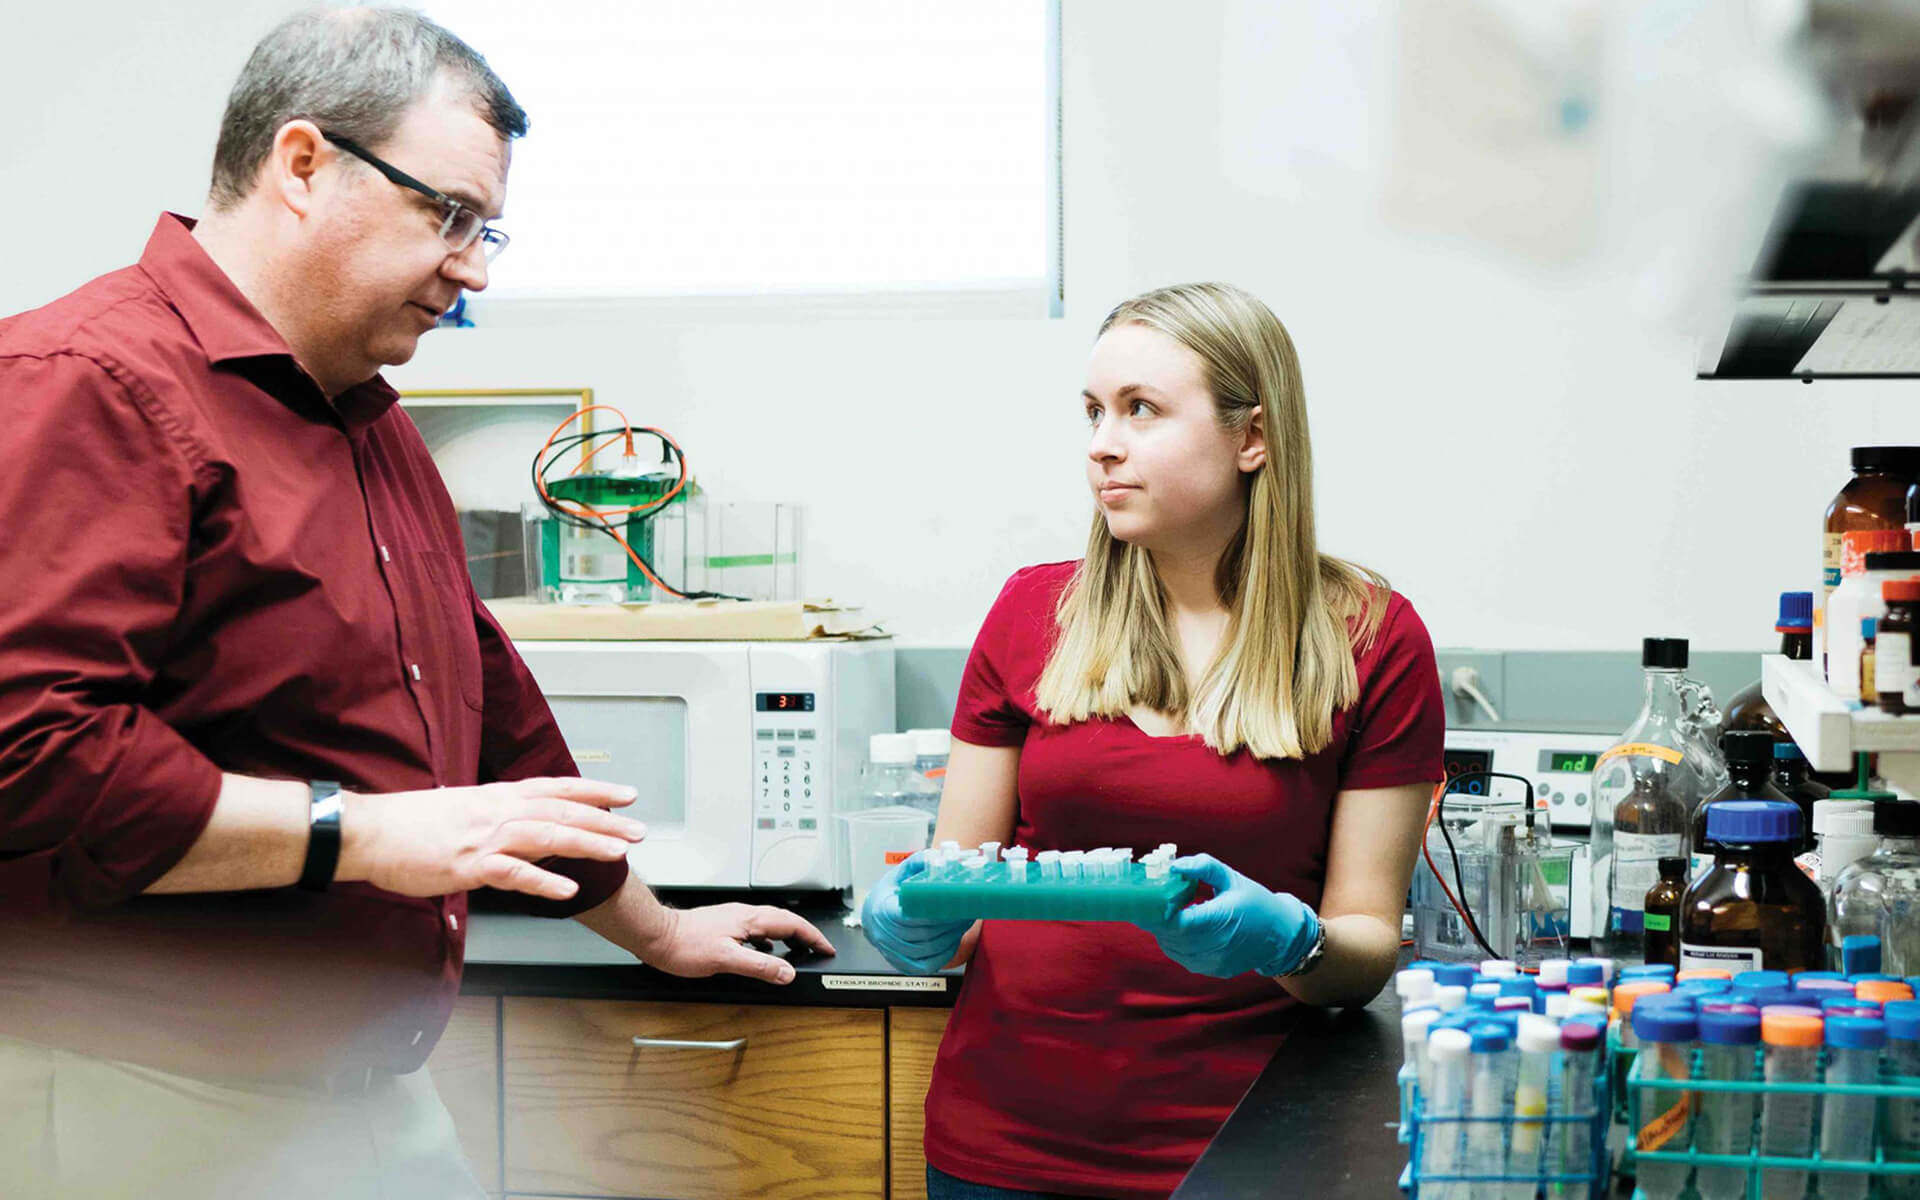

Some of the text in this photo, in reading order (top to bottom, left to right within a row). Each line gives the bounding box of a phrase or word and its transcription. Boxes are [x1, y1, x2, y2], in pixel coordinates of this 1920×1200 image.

[783, 761, 790, 770] 2
[804, 761, 810, 770] 3
[762, 775, 810, 784] 4 5 6
[763, 788, 769, 797] 7
[803, 788, 811, 798] 9
[783, 802, 790, 812] 0
